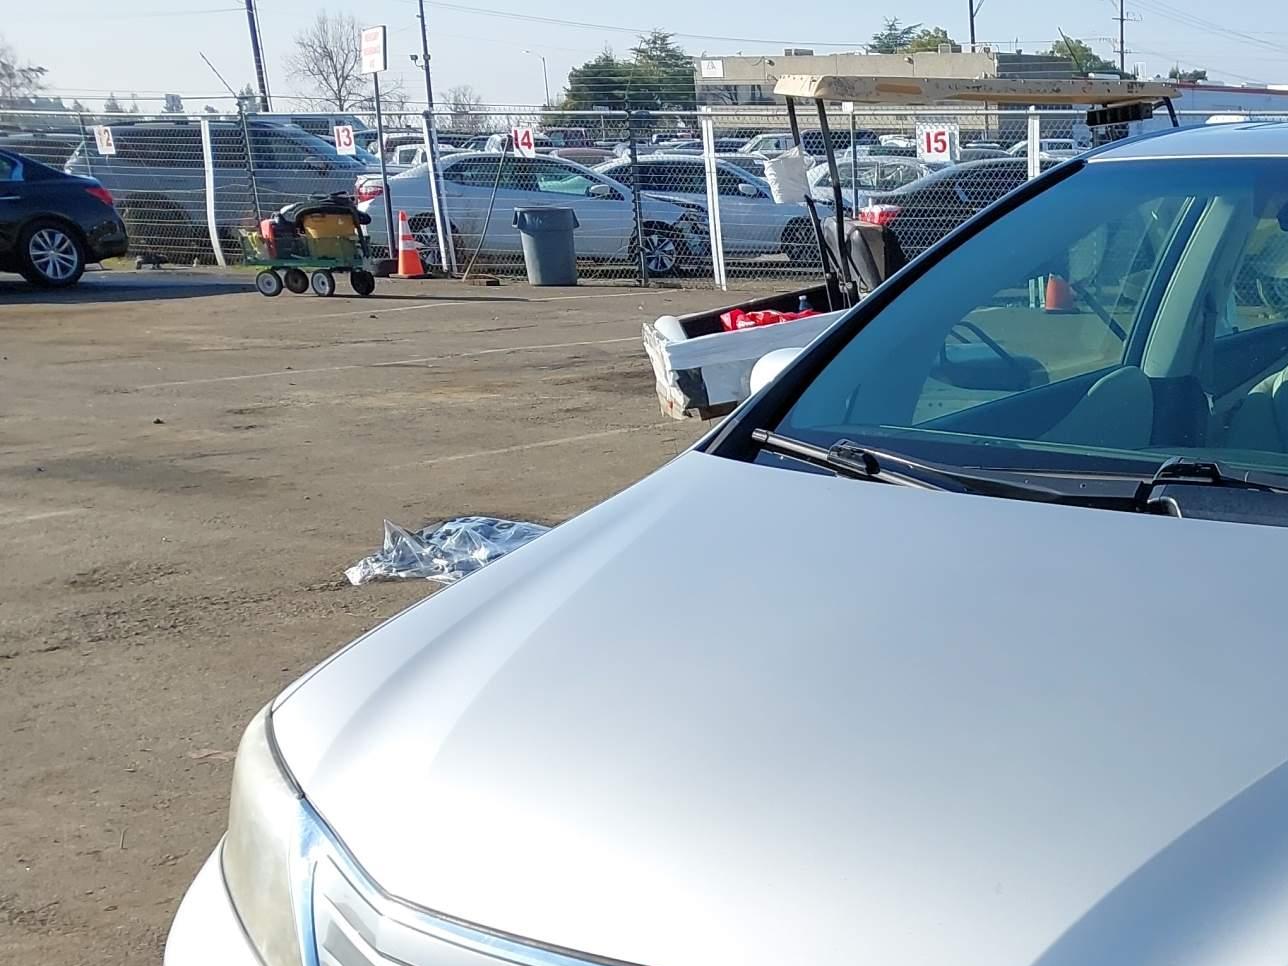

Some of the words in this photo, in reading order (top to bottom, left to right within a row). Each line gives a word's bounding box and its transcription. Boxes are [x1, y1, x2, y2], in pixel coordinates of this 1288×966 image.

[336, 127, 353, 147] 13
[513, 129, 533, 150] 14
[925, 130, 947, 153] 15
